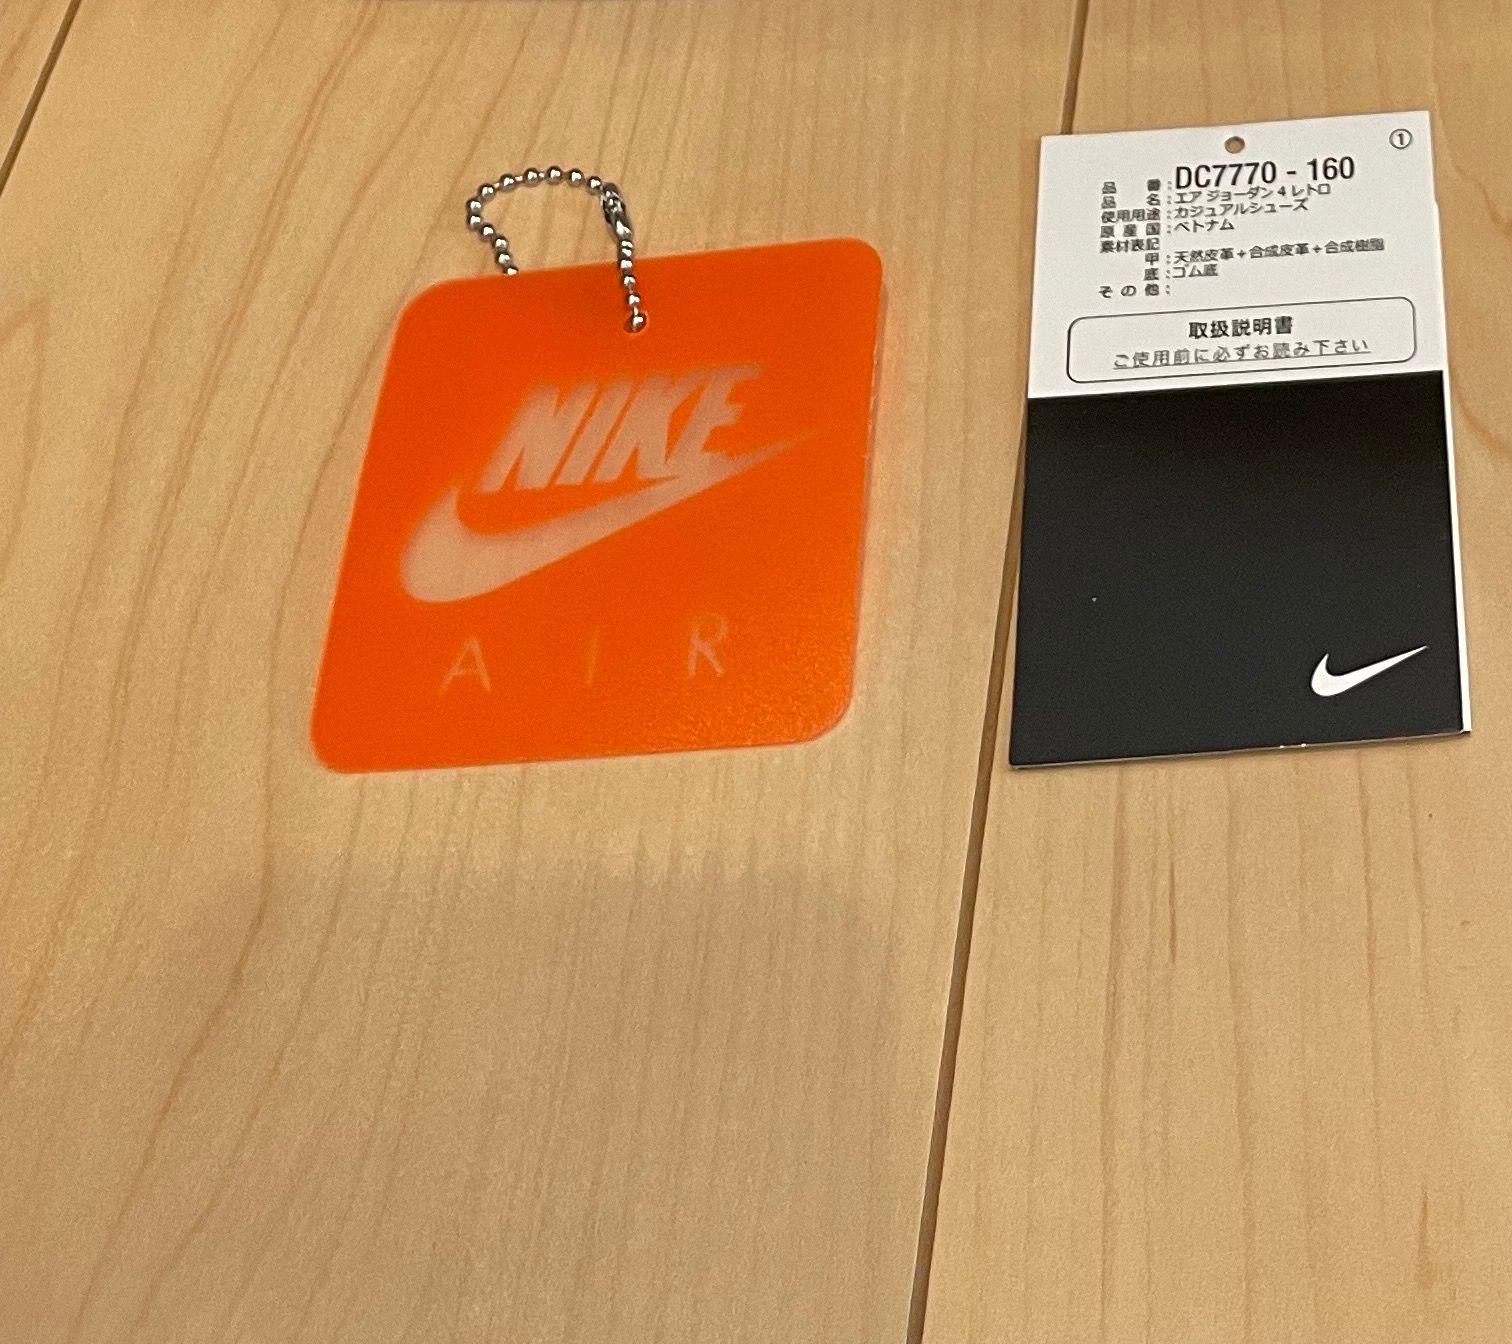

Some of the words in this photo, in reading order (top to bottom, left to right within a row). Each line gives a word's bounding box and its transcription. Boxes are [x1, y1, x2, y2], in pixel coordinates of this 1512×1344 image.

[1175, 160, 1277, 190] DC7770
[1307, 156, 1355, 181] 160
[1174, 218, 1235, 233] ベトナム
[1188, 315, 1293, 339] 取扱説明書
[477, 362, 763, 494] NIKE
